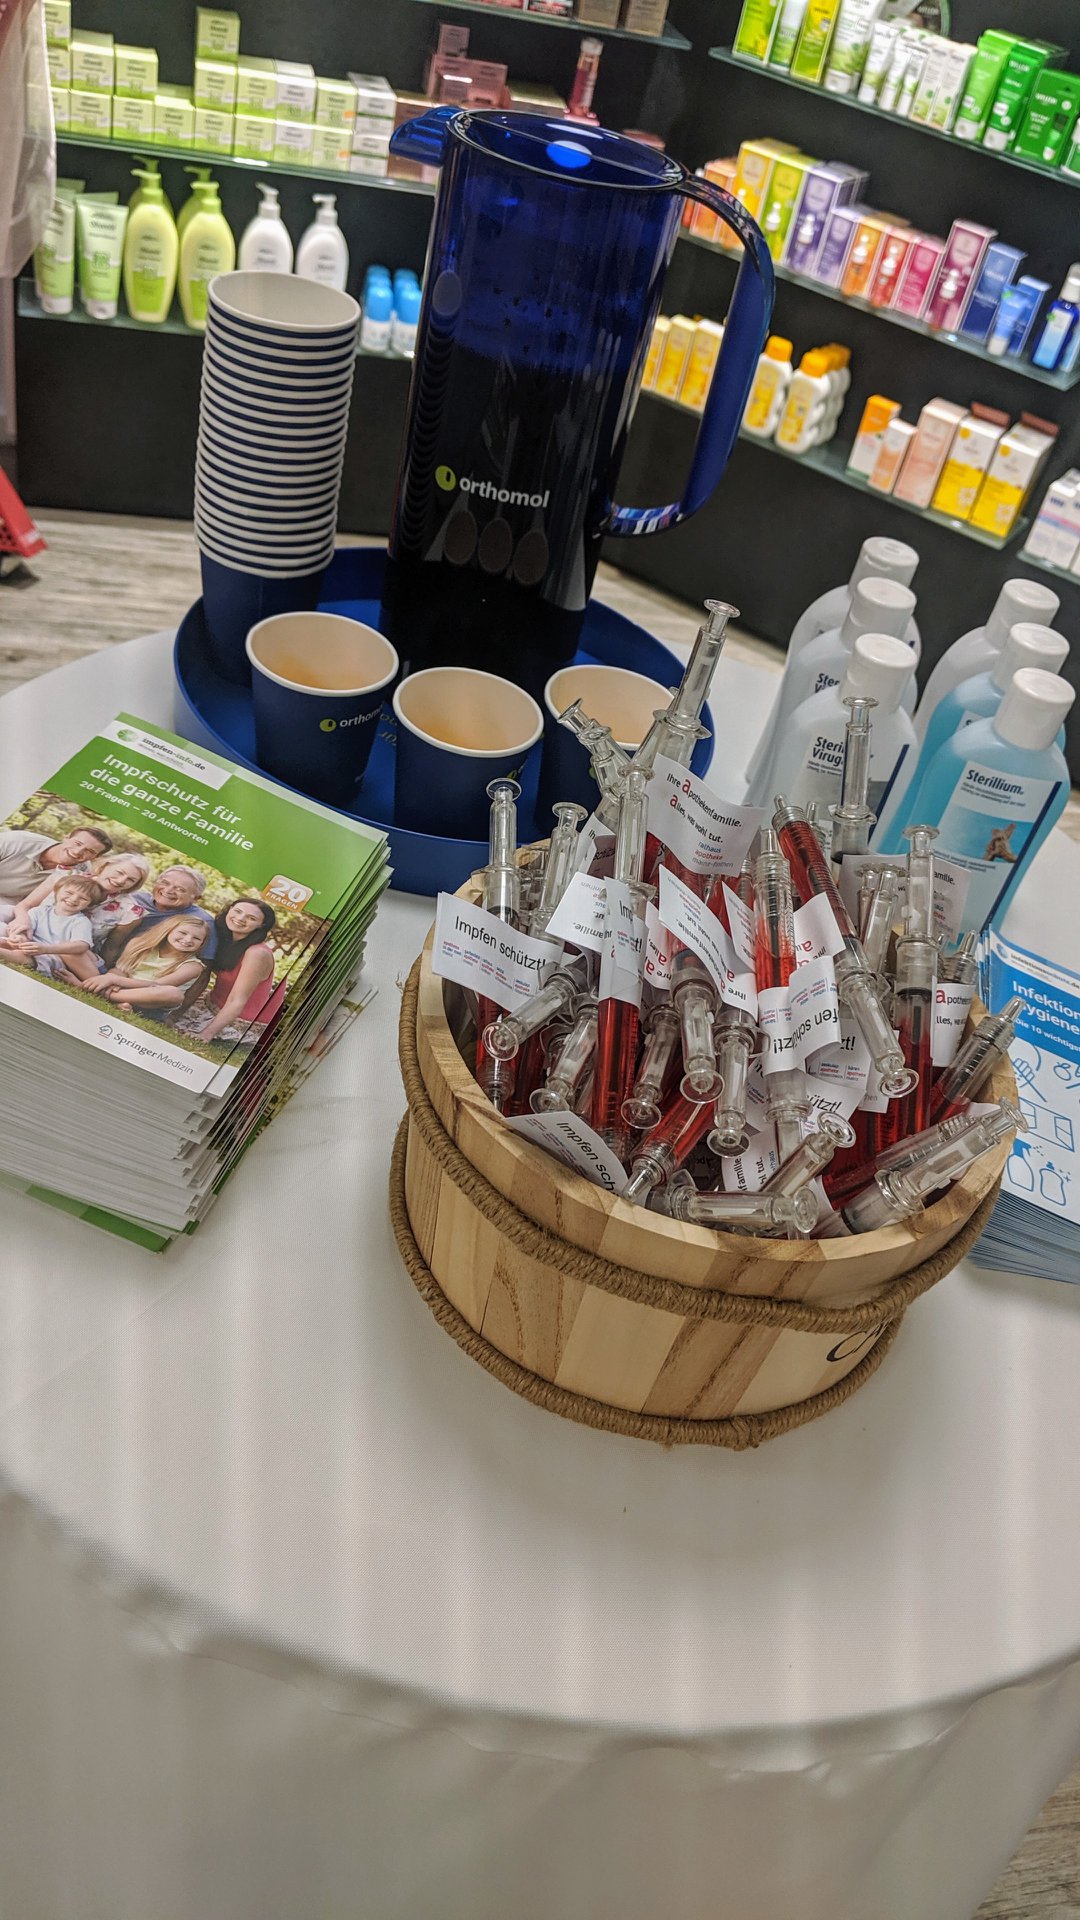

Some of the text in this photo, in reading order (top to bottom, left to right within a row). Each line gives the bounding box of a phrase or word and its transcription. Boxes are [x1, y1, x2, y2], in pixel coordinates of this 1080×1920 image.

[459, 477, 550, 508] orthomol
[142, 737, 206, 771] impfen-info.de
[103, 754, 210, 810] Impfschutz
[212, 805, 242, 825] für
[666, 772, 681, 788] Ihre
[79, 780, 95, 791] 20
[95, 787, 131, 808] Fragen
[141, 809, 158, 820] 20
[156, 817, 209, 846] Antworten
[90, 768, 254, 851] die ganze Familie
[694, 819, 708, 838] wohl
[708, 833, 723, 843] tut.
[265, 891, 298, 910] FRAGEN
[269, 879, 307, 903] 20
[455, 915, 497, 949] Impfen
[1022, 1002, 1080, 1036] ygiene
[1031, 1024, 1042, 1034] 10
[556, 1122, 598, 1160] Impfen
